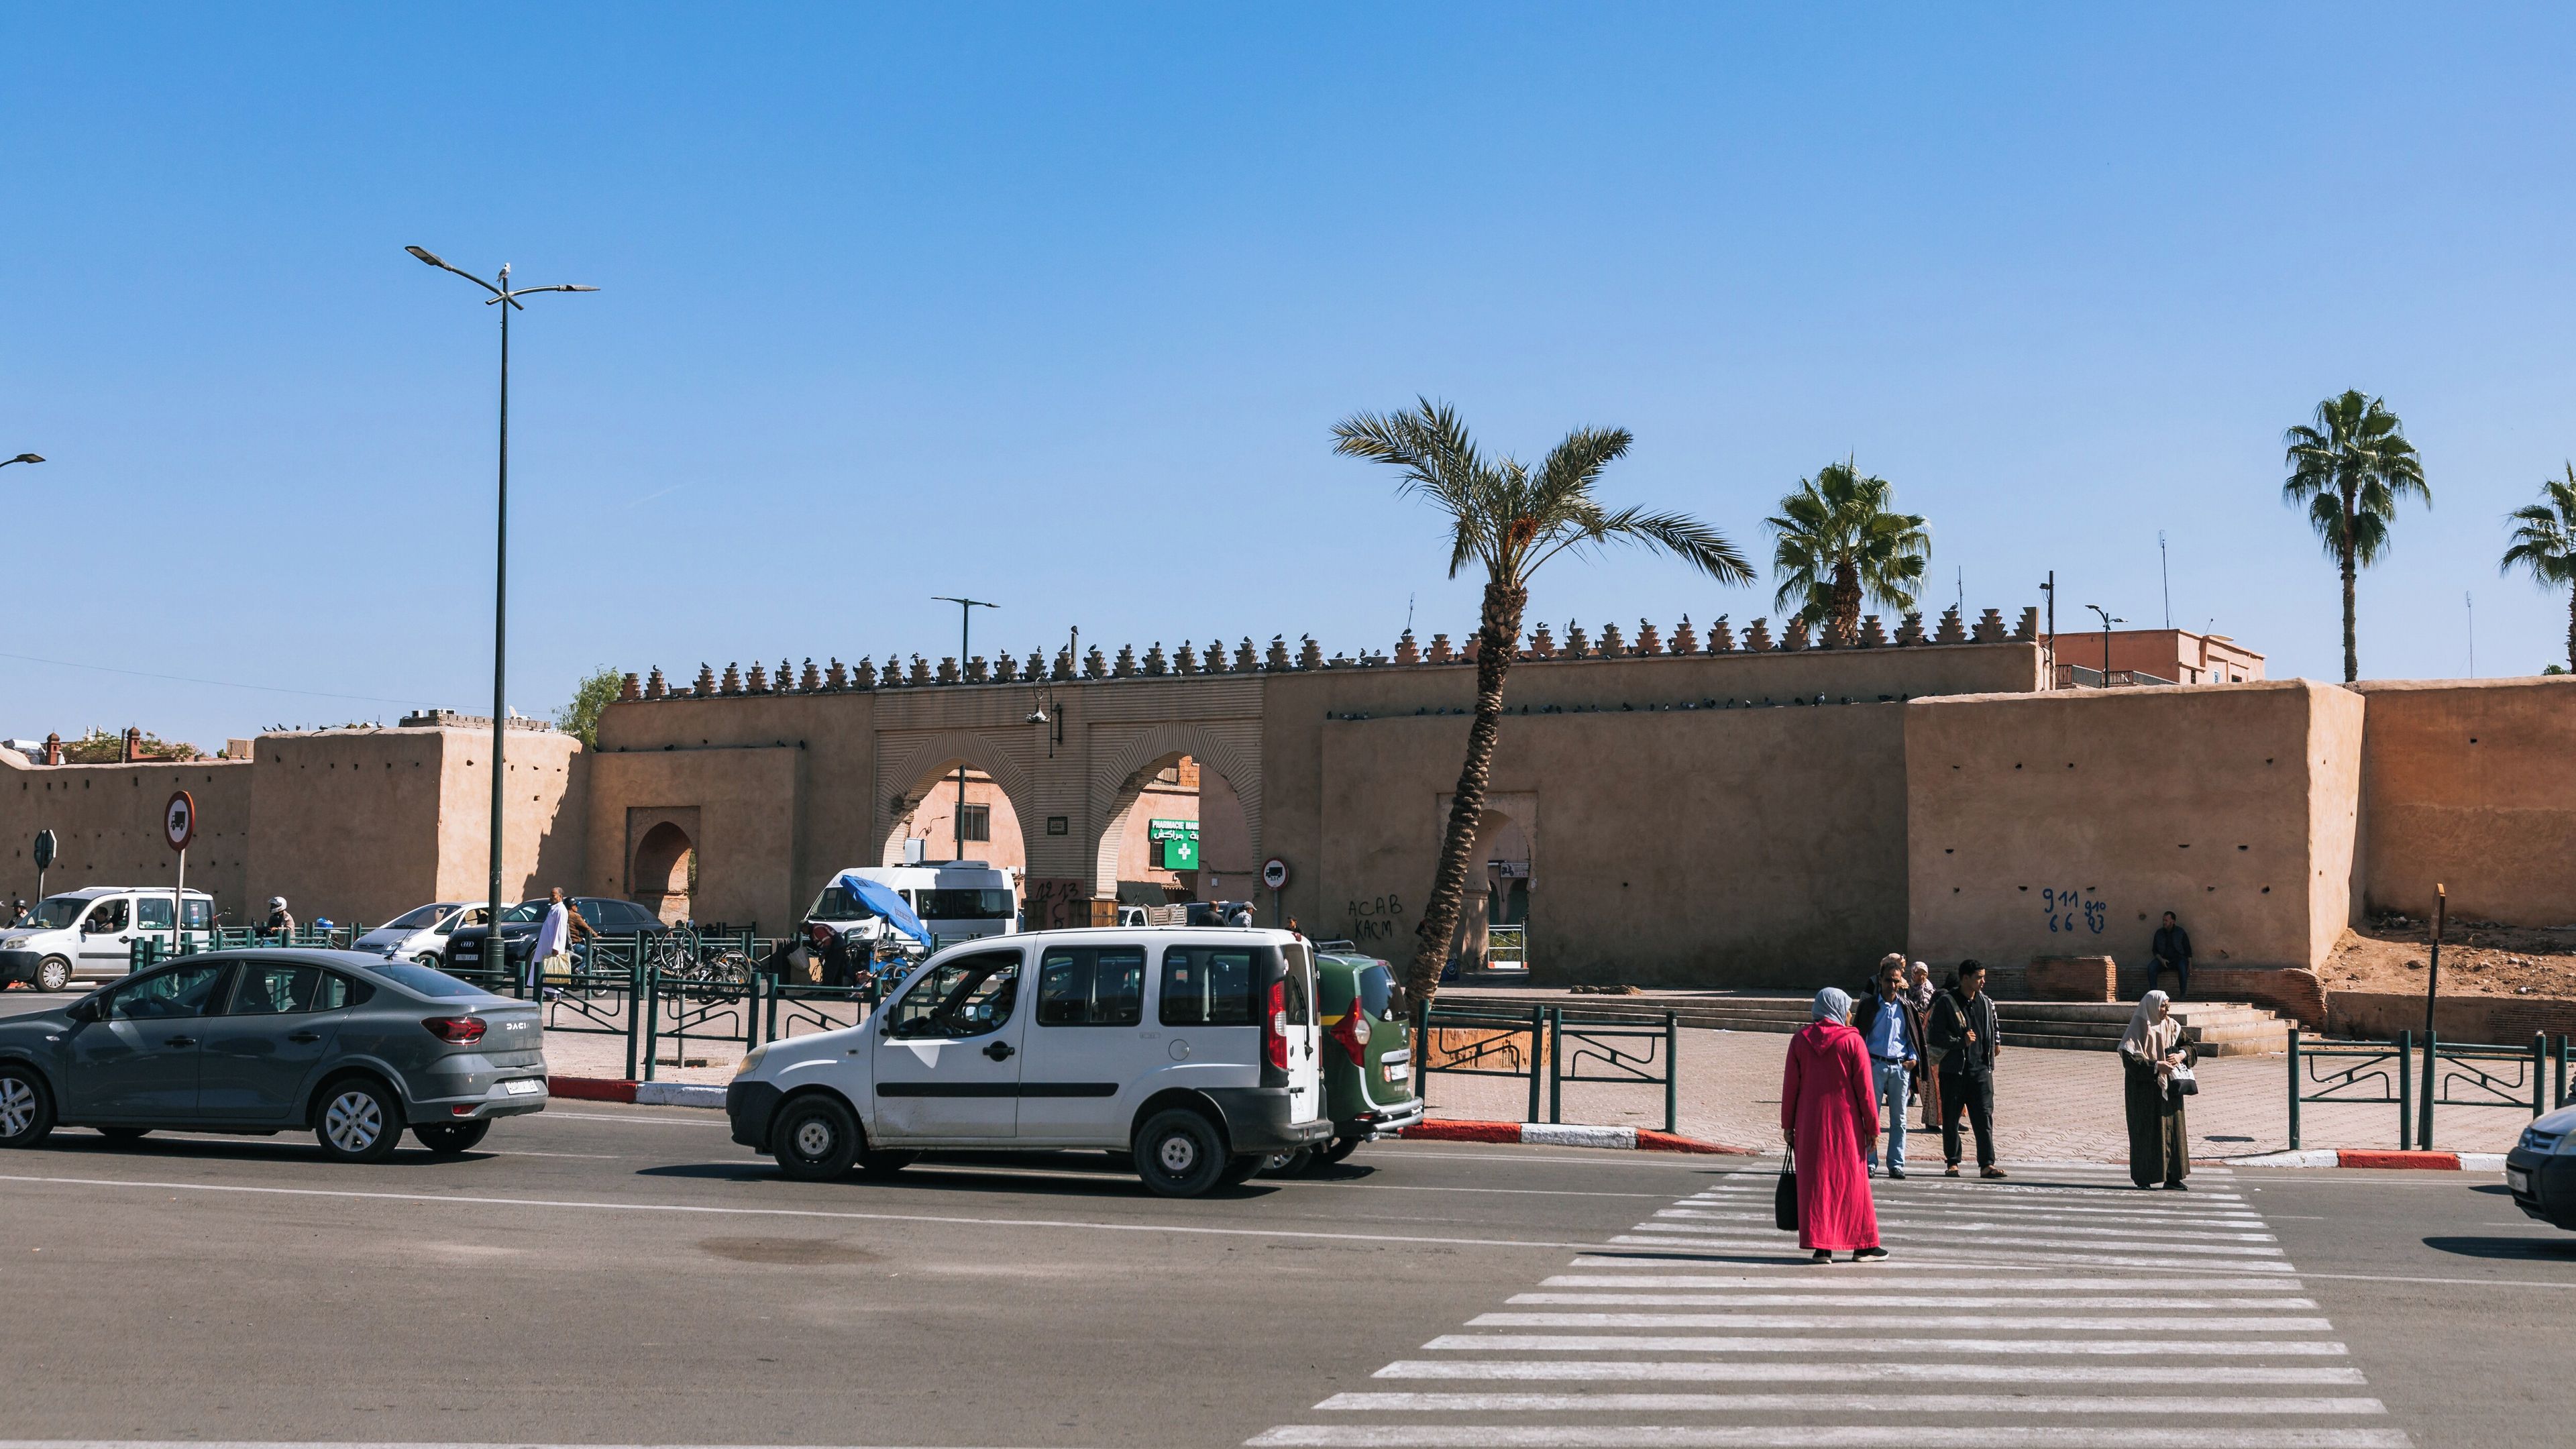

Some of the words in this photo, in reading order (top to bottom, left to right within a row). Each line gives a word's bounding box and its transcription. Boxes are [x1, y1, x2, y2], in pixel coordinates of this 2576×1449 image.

[1152, 820, 1185, 829] PHARMACIE
[1154, 828, 1184, 840] مراكش
[1059, 882, 1079, 903] 13
[2043, 888, 2078, 913] 911
[2084, 900, 2106, 917] 910
[1355, 918, 1393, 940] KACM
[2049, 912, 2073, 932] 66
[506, 1022, 531, 1030] DACIA
